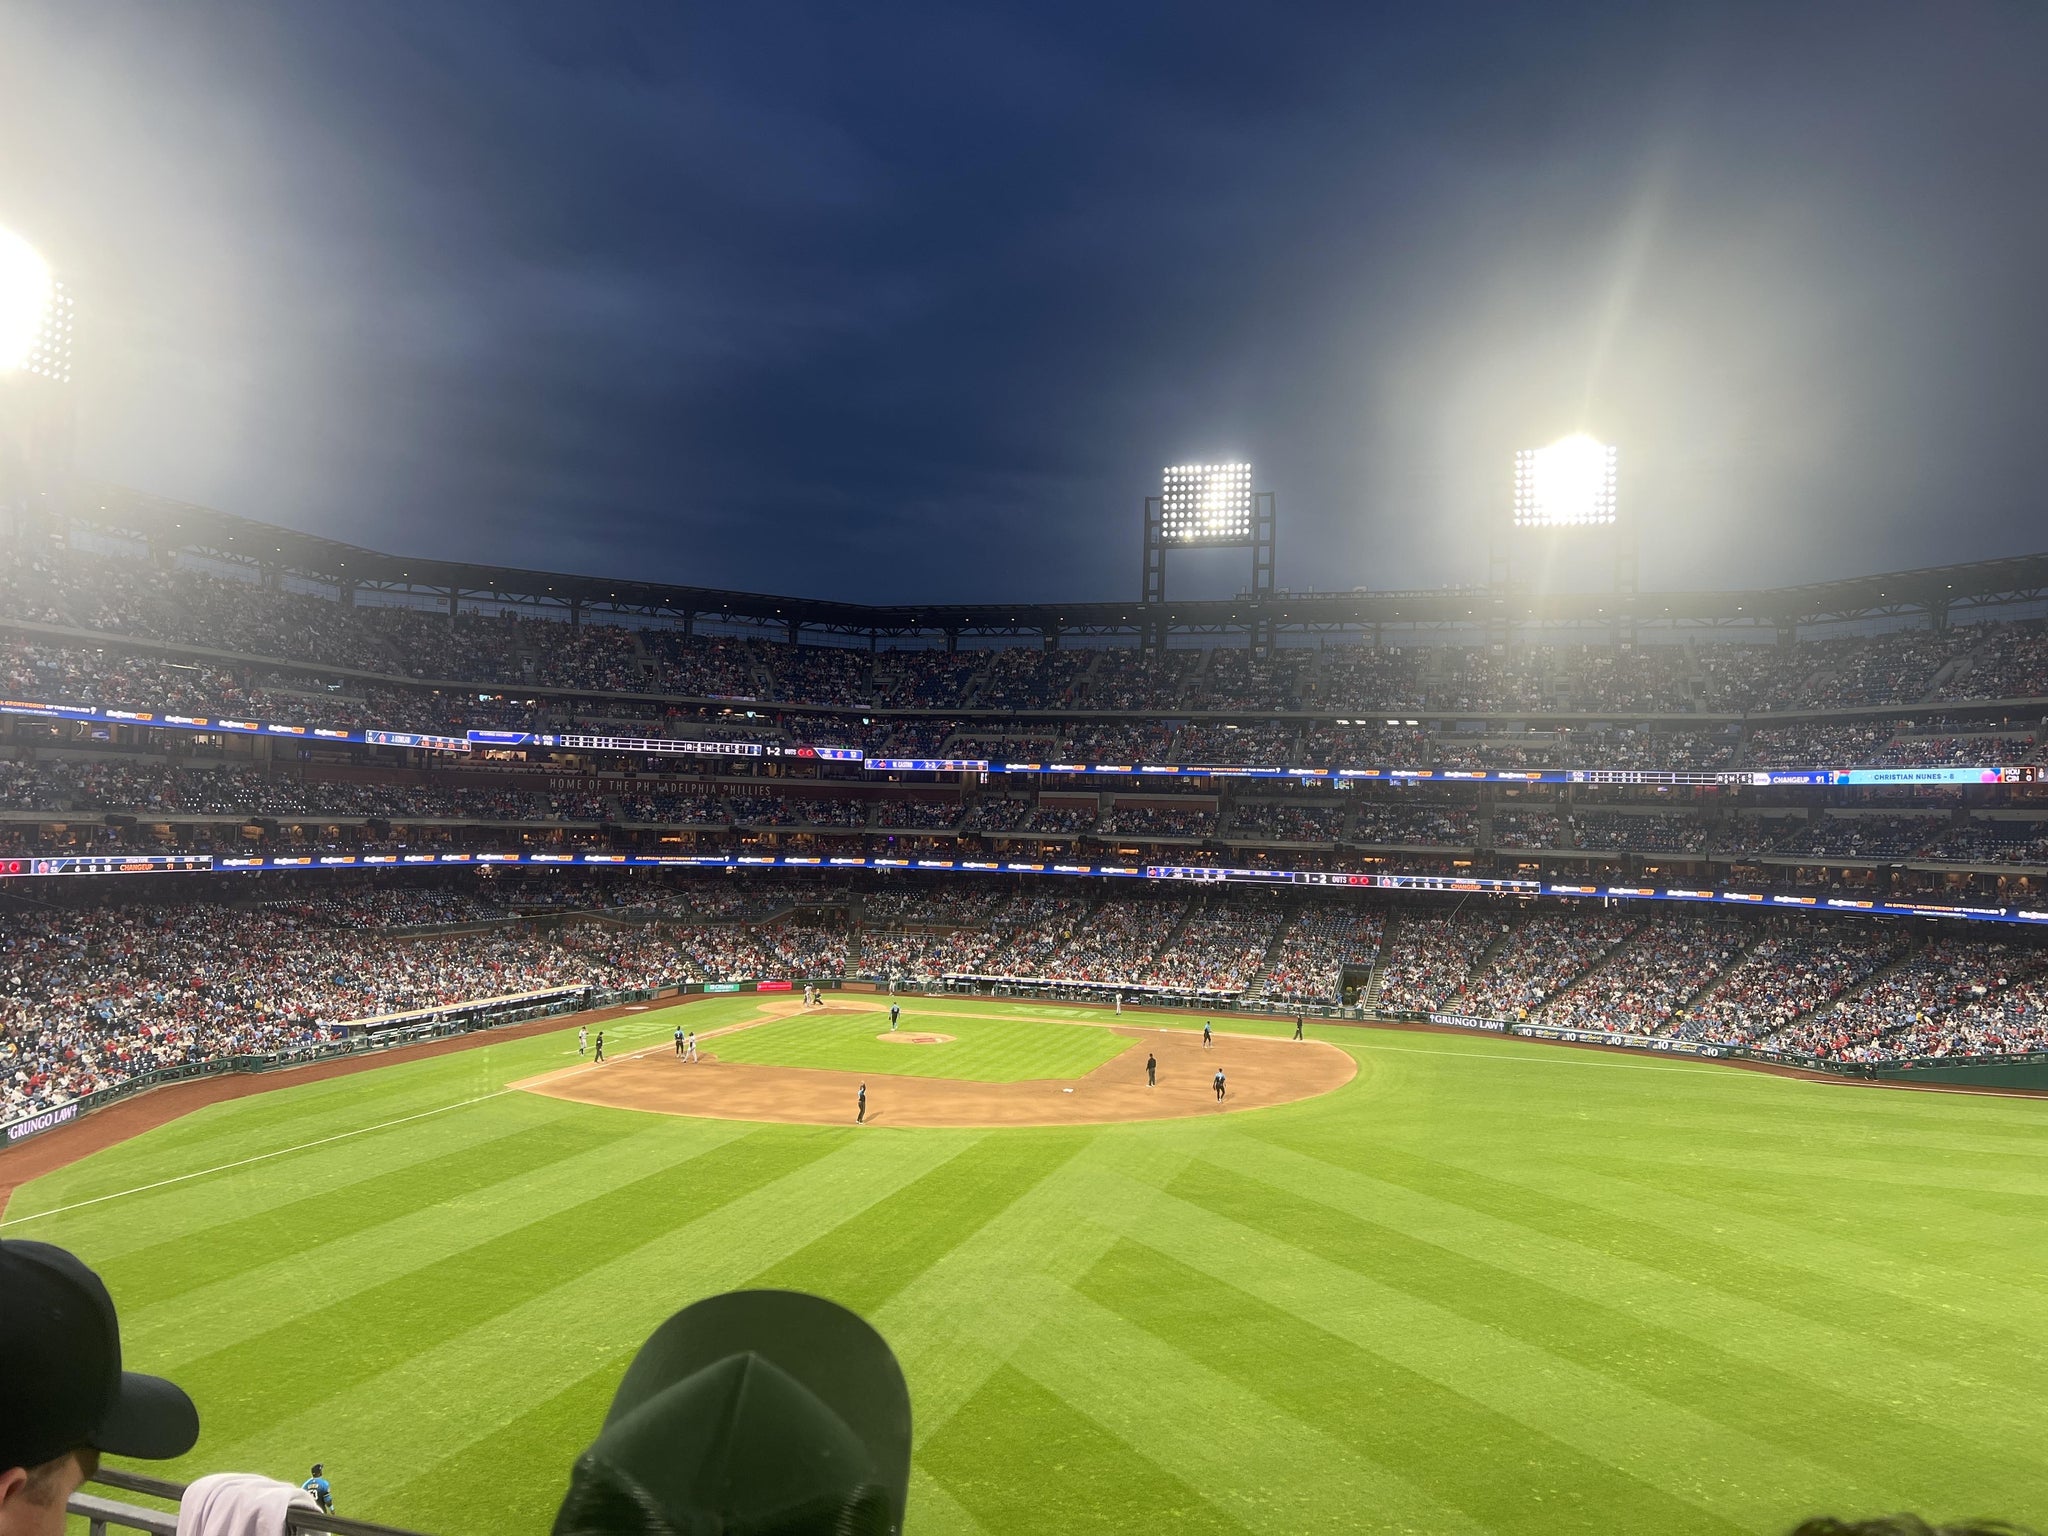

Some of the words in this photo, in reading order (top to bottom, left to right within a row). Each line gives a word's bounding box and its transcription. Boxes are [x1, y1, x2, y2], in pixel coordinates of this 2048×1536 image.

[1773, 776, 1810, 784] CHANGEUP
[1815, 775, 1825, 784] 91
[550, 778, 583, 790] HOME
[588, 780, 602, 791] OF
[609, 780, 630, 791] THE
[119, 863, 154, 871] CHANGEUP
[1332, 875, 1347, 884] OUTS
[1434, 1015, 1478, 1028] GRUNGO
[1479, 1020, 1499, 1030] LAW
[1522, 1028, 1532, 1037] 10
[1566, 1032, 1577, 1041] 10
[1611, 1036, 1622, 1045] 10
[1657, 1041, 1669, 1050] 10
[1707, 1048, 1719, 1057] 10
[10, 1113, 52, 1140] GRUNGO
[54, 1106, 73, 1125] LAW
